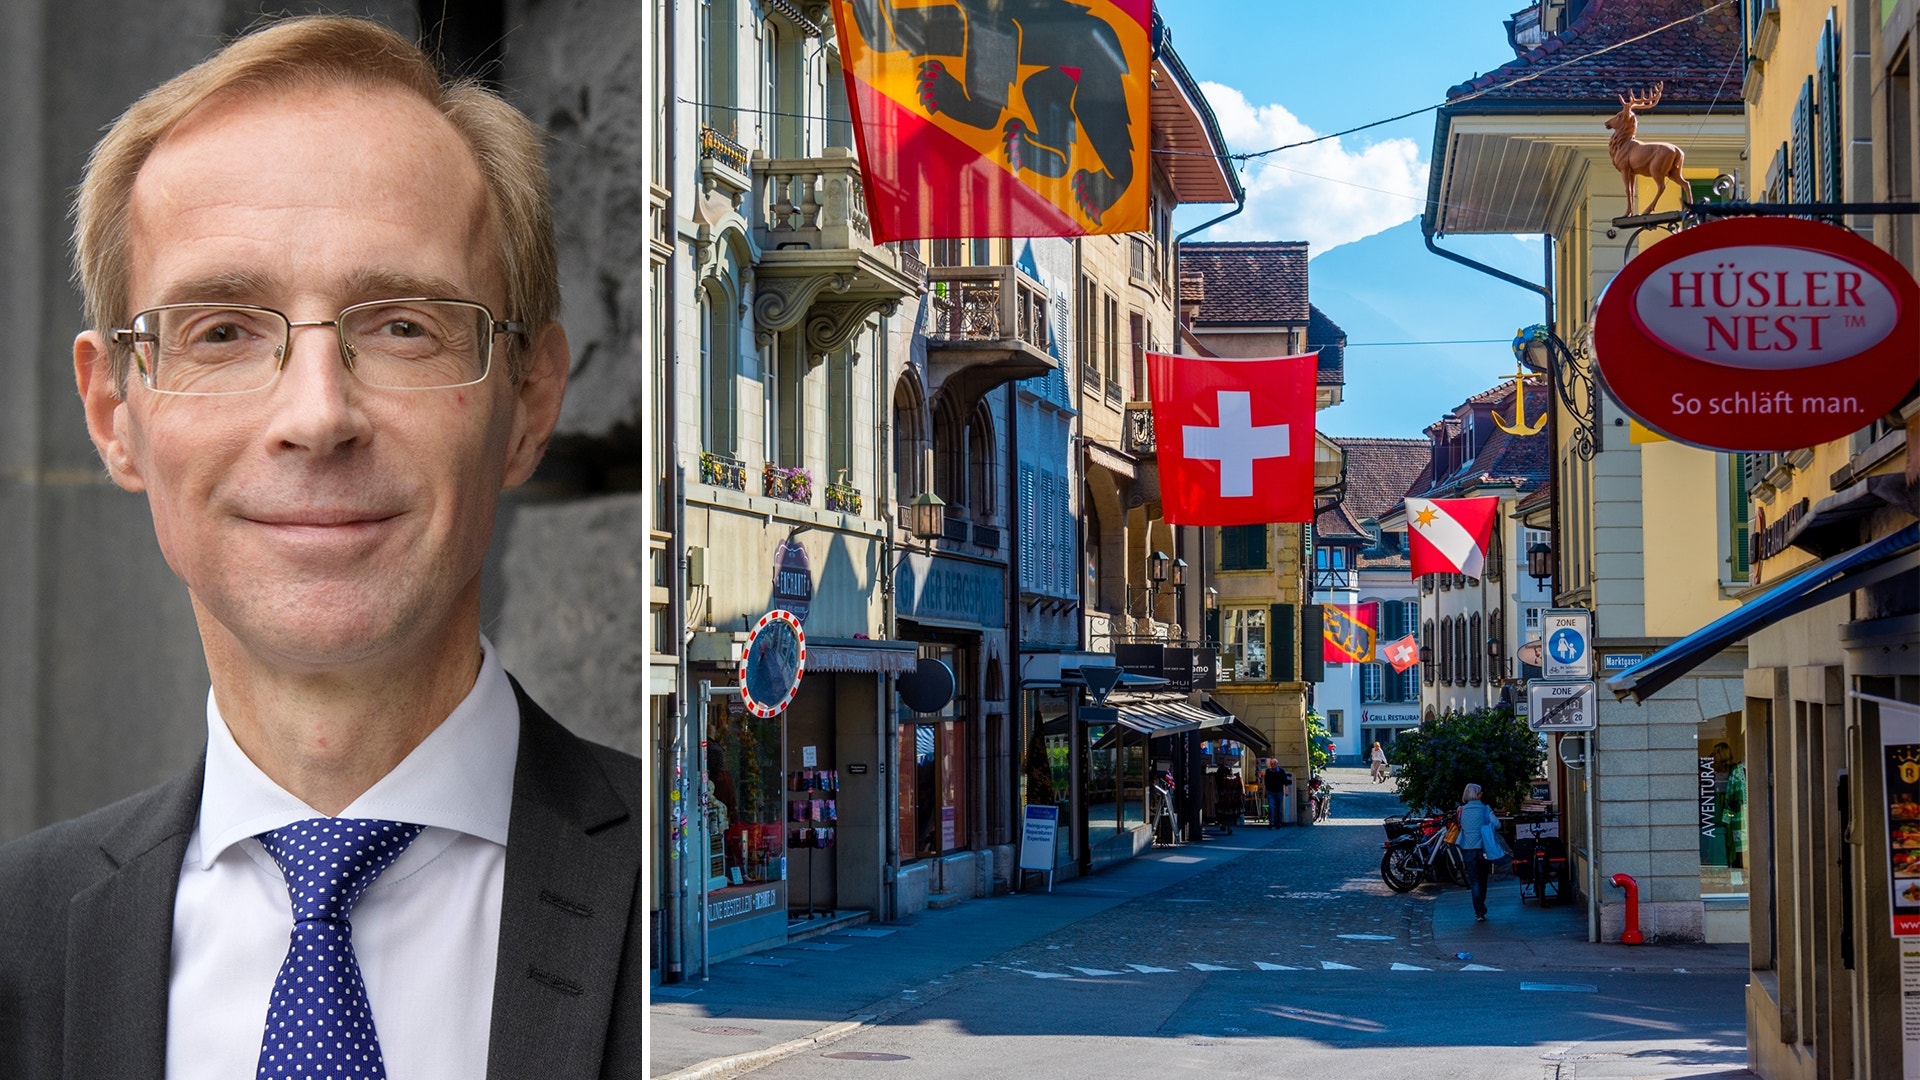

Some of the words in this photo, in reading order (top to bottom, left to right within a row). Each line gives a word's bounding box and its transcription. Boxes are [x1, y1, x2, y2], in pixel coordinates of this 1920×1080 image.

[1669, 262, 1866, 308] HÜSLER
[1704, 314, 1831, 351] NEST
[1844, 315, 1866, 328] TM
[1672, 393, 1701, 416] So
[1709, 391, 1794, 415] schläft
[1802, 395, 1865, 414] man.
[945, 570, 998, 616] BERGSPORT
[1552, 687, 1572, 695] ZONE
[1574, 713, 1583, 721] 20
